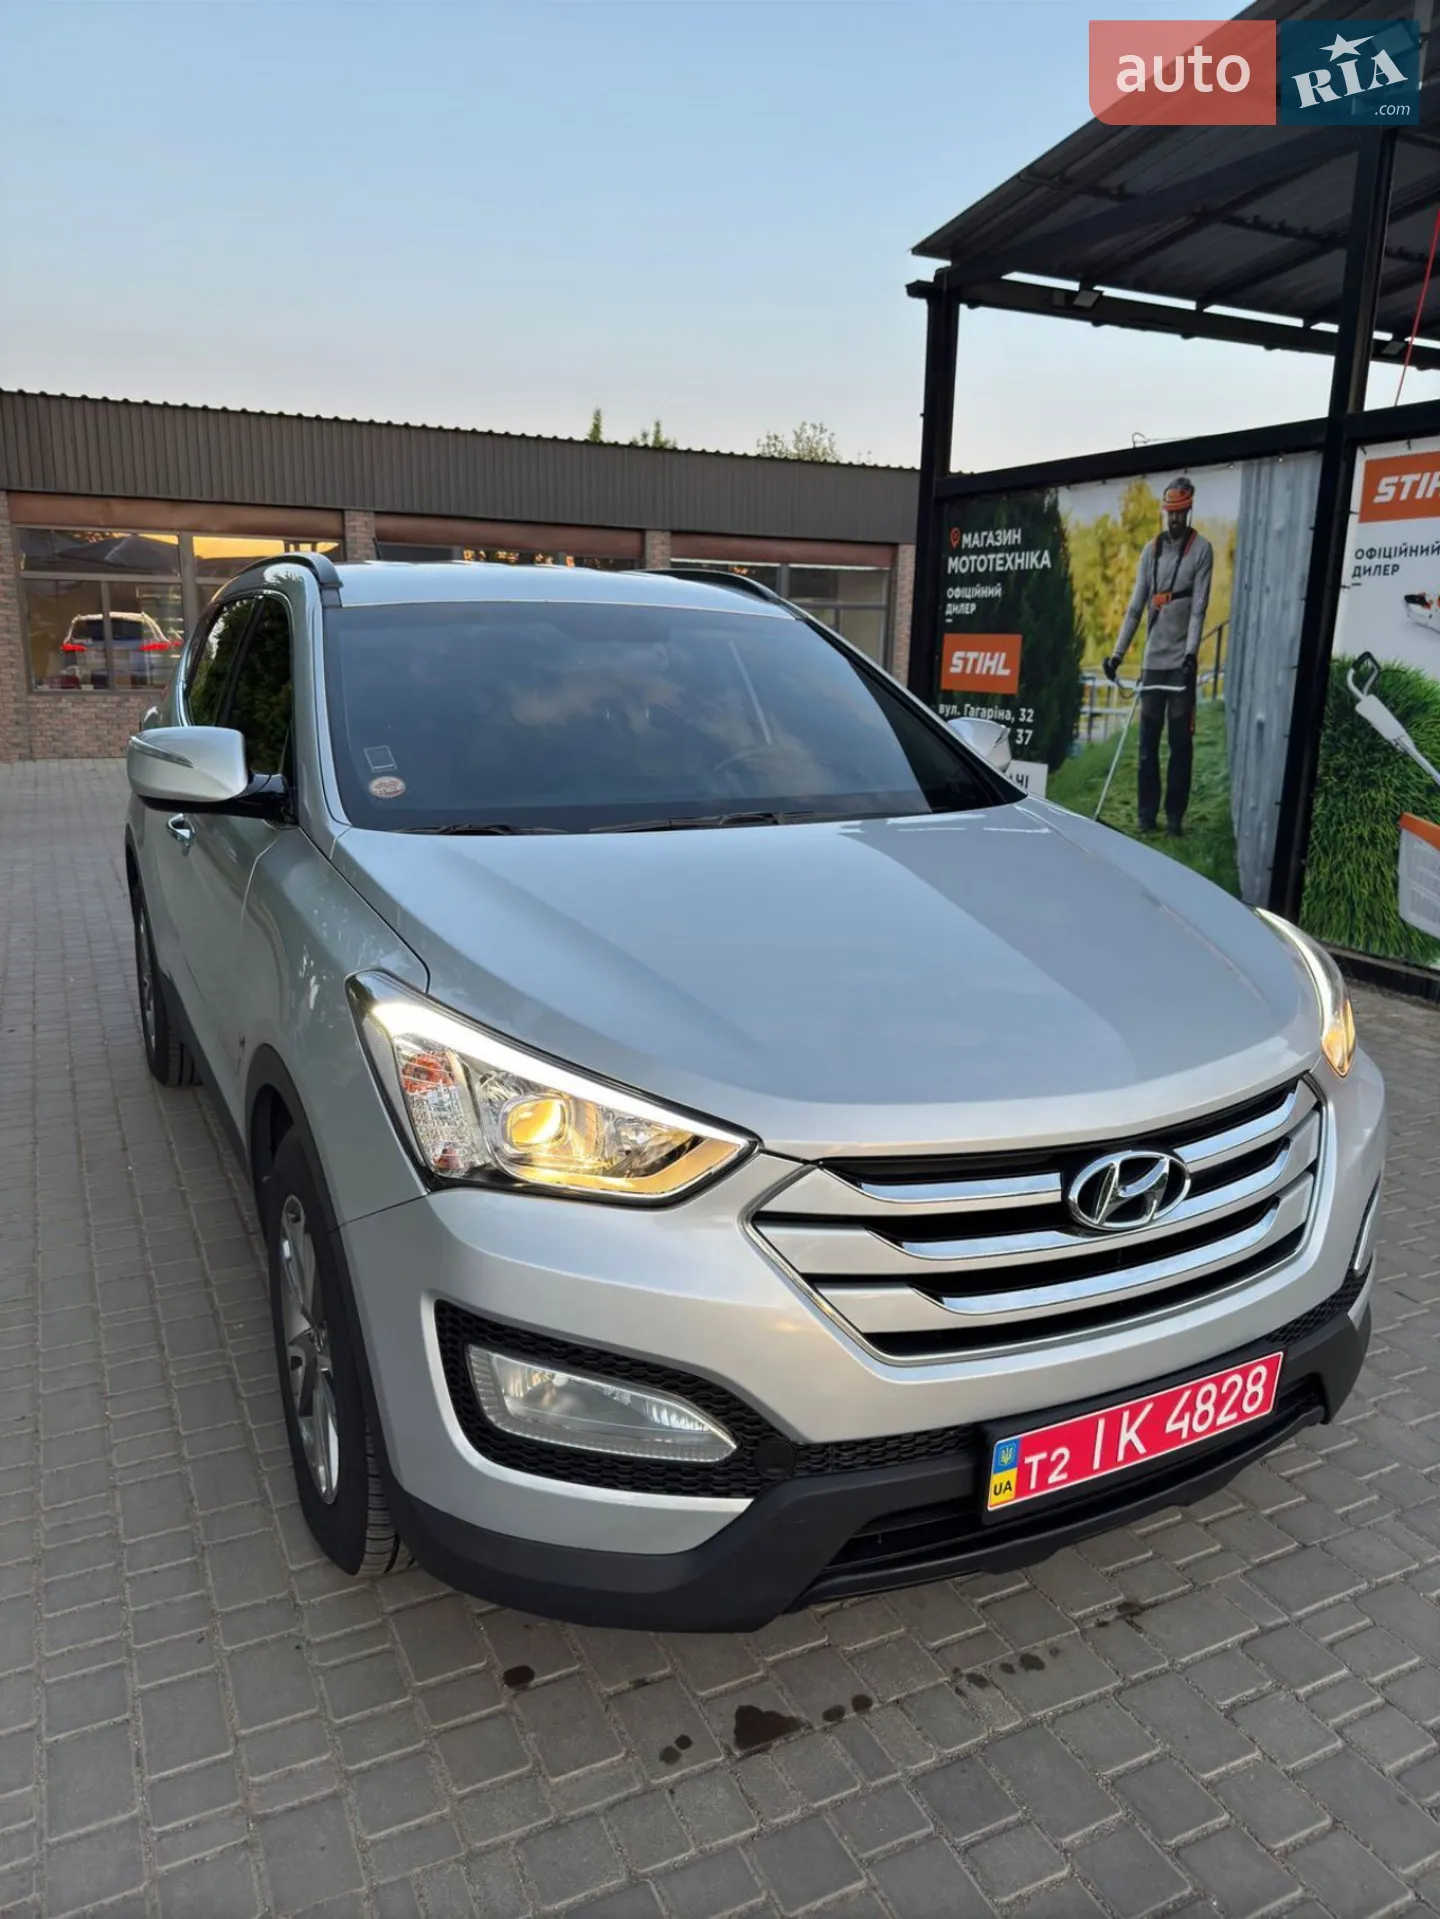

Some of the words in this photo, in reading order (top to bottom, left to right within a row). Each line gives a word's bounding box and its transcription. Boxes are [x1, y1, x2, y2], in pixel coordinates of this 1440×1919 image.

[961, 528, 1022, 549] МАГАЗИН
[1354, 541, 1440, 560] ОФІЦІЙНИЙ
[947, 549, 1052, 575] МОТОТЕХНІКА
[1351, 563, 1400, 579] ДИЛЕР
[946, 583, 1002, 600] ОФІЦІЙНИЙ
[945, 602, 977, 616] ДИЛЕР
[949, 650, 1011, 676] STIHL
[938, 703, 961, 717] вул.
[963, 703, 1015, 724] Гагаріна,
[1018, 708, 1035, 723] 32
[1024, 1447, 1071, 1491] T2
[1092, 1402, 1154, 1471] IK
[1164, 1364, 1268, 1440] 4828
[993, 1482, 1013, 1497] UA
